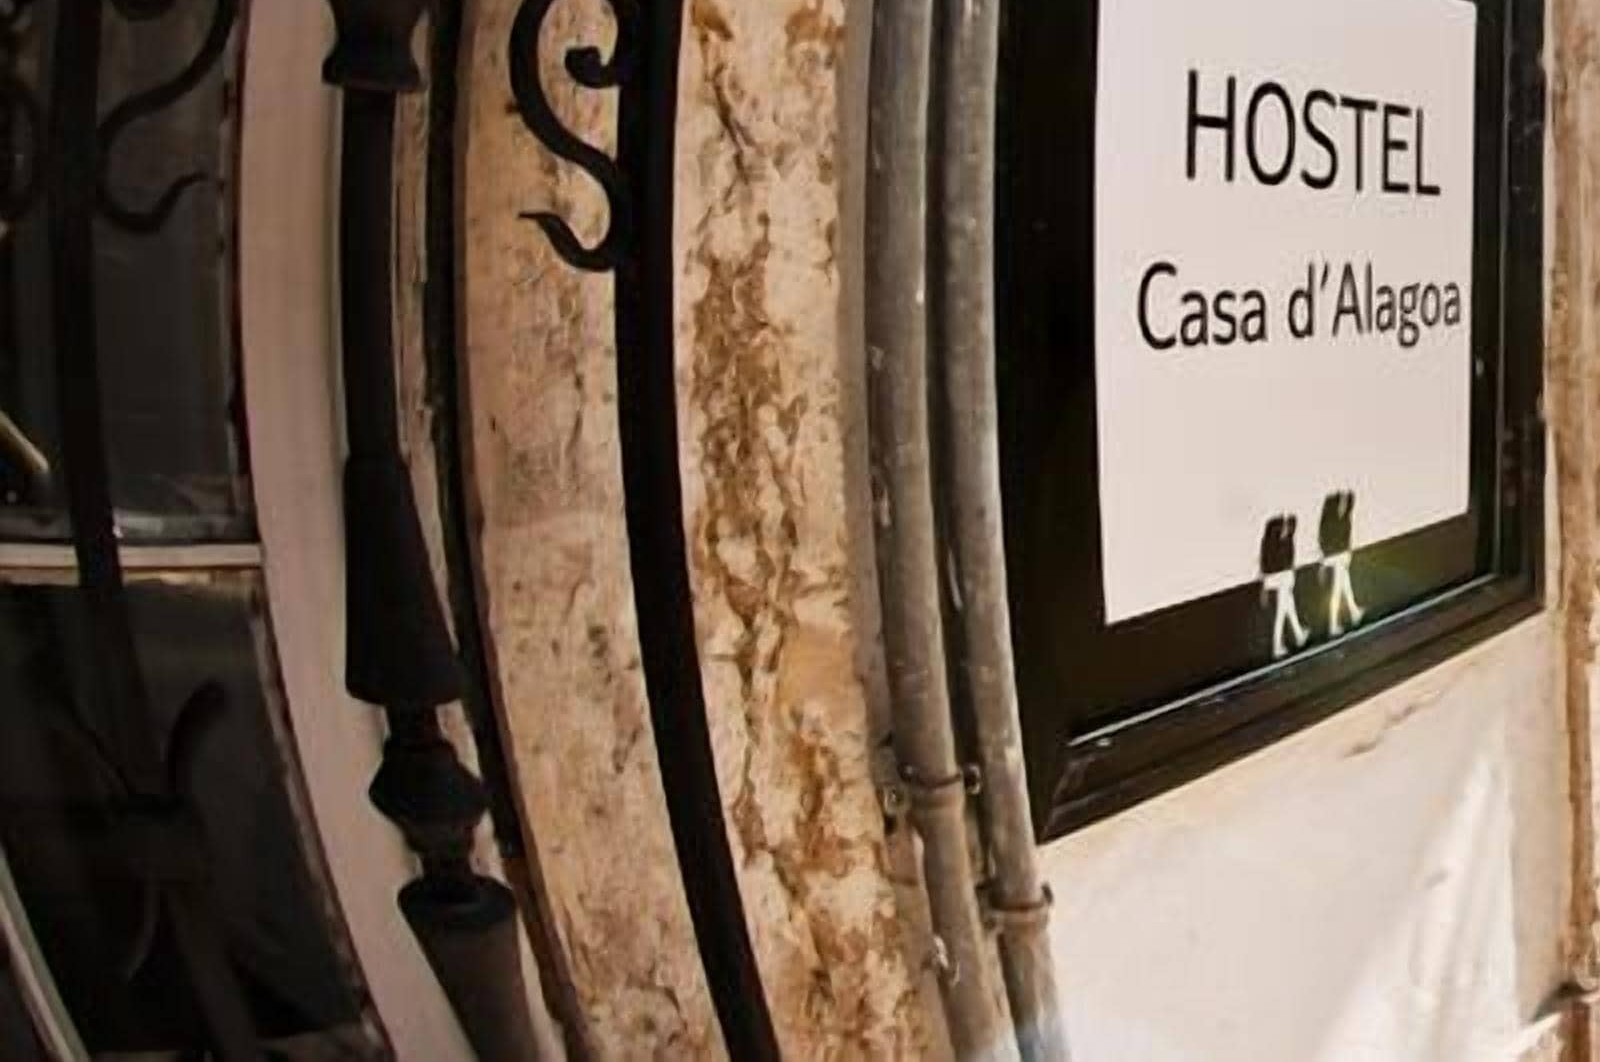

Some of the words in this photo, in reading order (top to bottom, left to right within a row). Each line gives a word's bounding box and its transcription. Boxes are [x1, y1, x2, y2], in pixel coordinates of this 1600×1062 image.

[1185, 69, 1441, 196] HOSTEL
[1136, 261, 1268, 351] Casa
[1287, 260, 1463, 348] d'Alagoa
